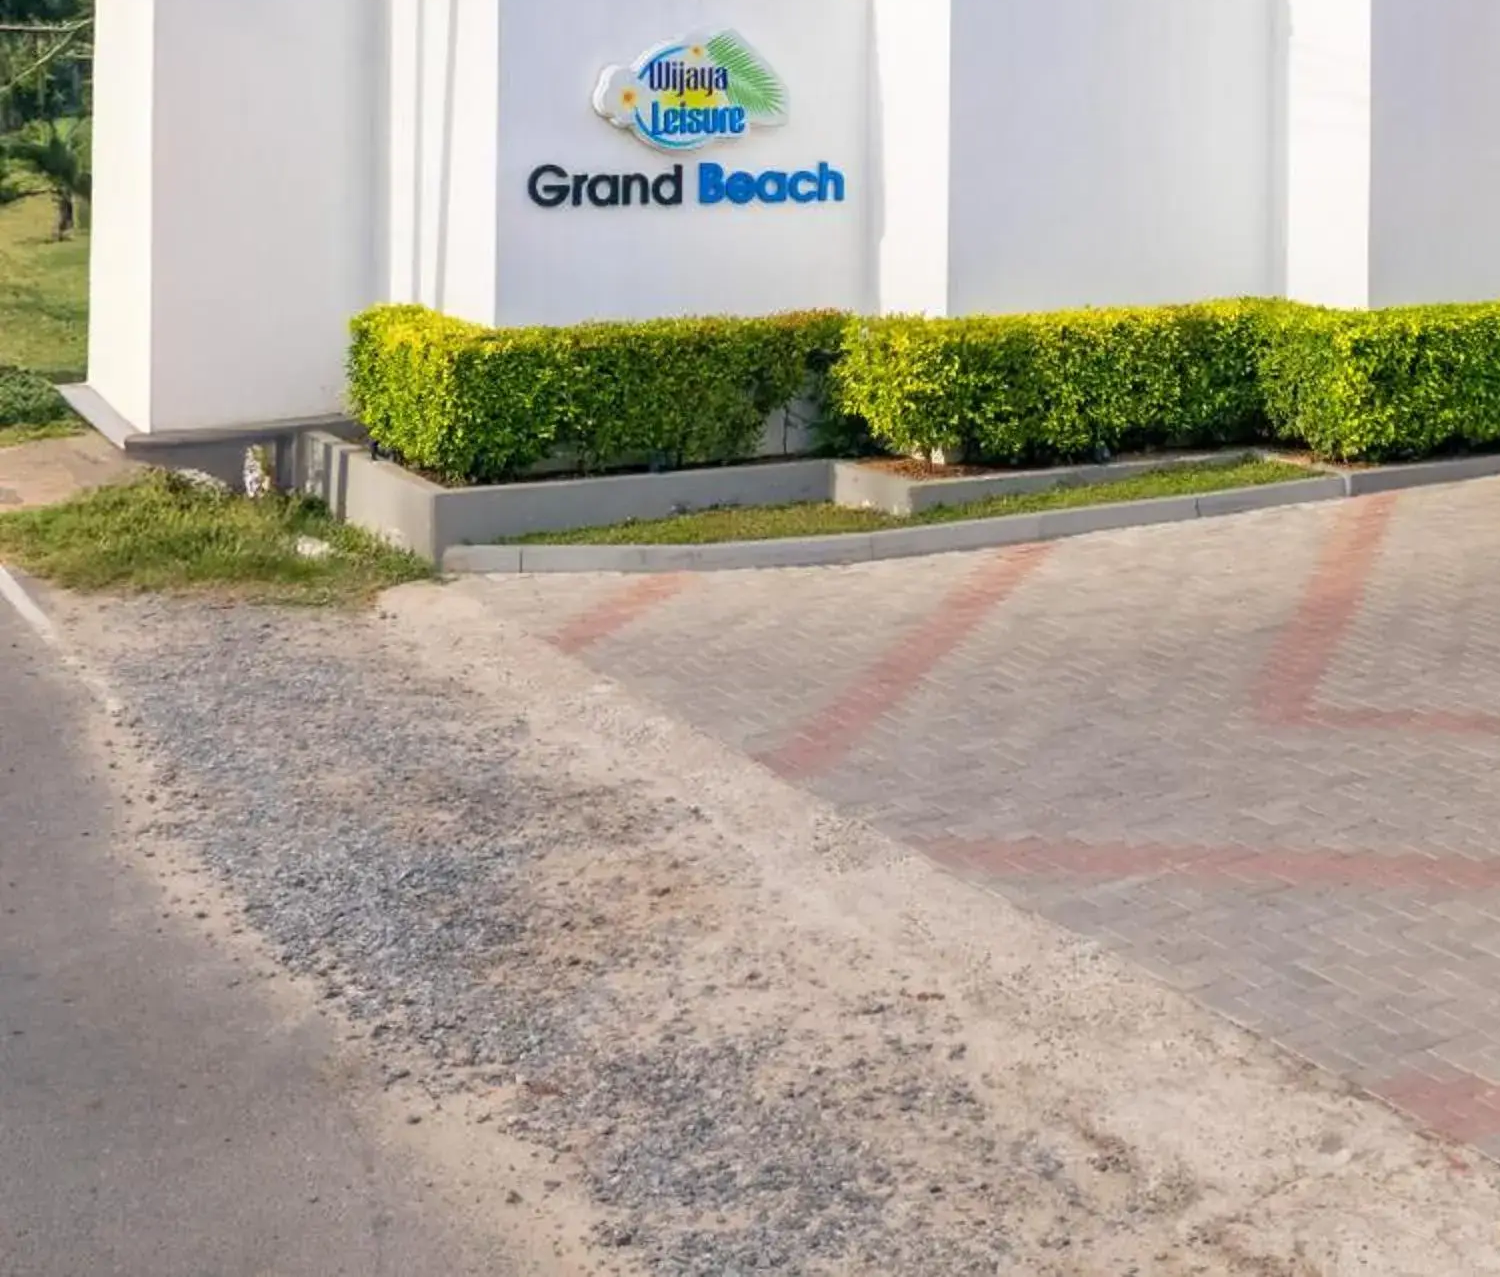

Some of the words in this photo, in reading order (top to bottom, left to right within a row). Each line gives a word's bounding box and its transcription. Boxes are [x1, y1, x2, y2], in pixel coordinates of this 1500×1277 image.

[649, 61, 728, 97] Wijaya
[651, 101, 746, 135] Leisure
[528, 164, 683, 207] Grand
[698, 161, 845, 204] Beach
